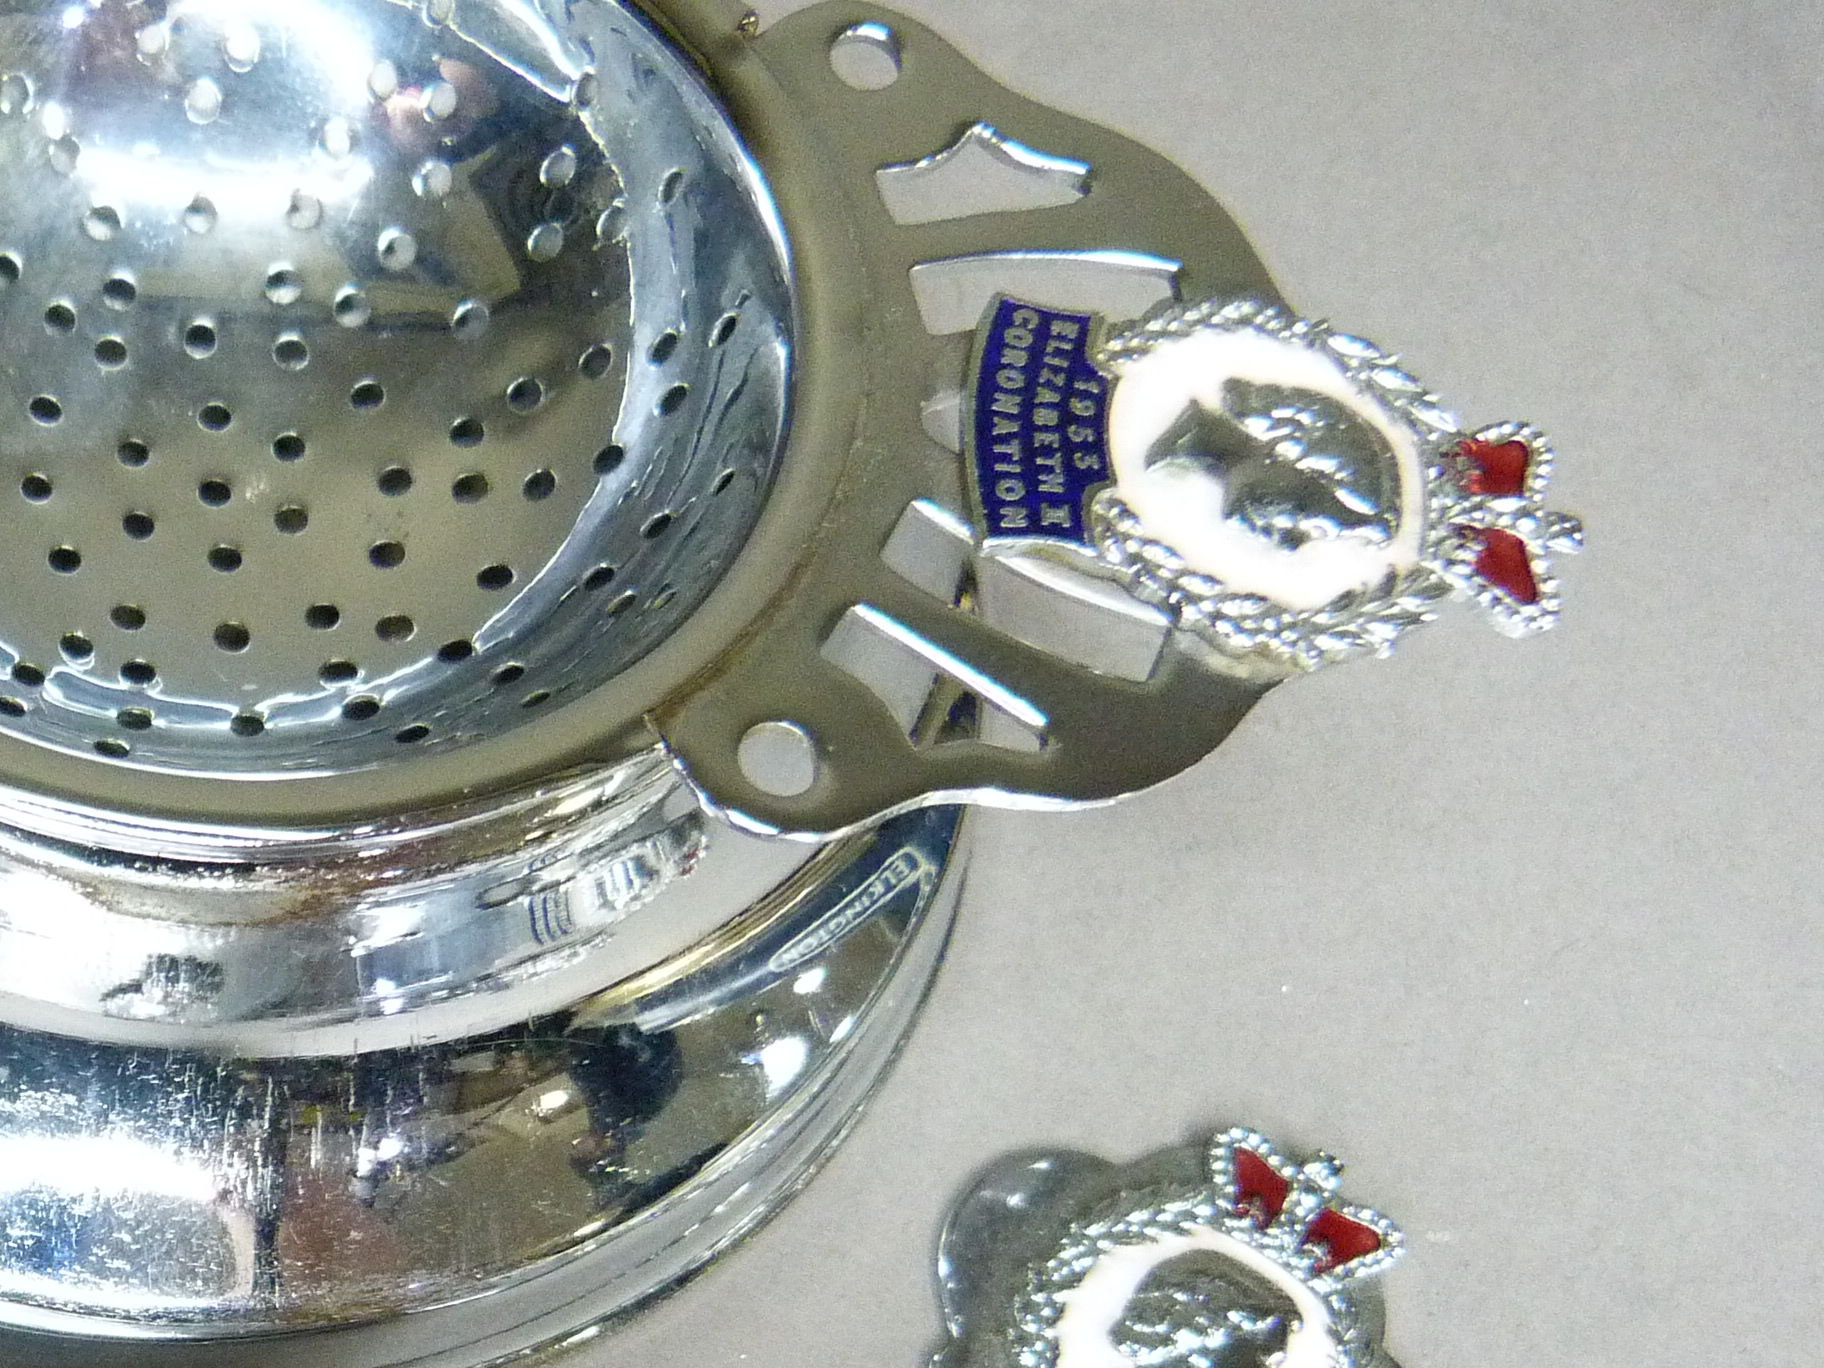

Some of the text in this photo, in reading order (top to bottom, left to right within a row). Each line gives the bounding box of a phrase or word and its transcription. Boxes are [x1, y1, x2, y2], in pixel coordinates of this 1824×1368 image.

[990, 308, 1039, 528] CORONATION
[1032, 319, 1079, 493] ELIZABETH
[1067, 379, 1100, 470] 1953
[780, 858, 911, 961] ELKINGTON
